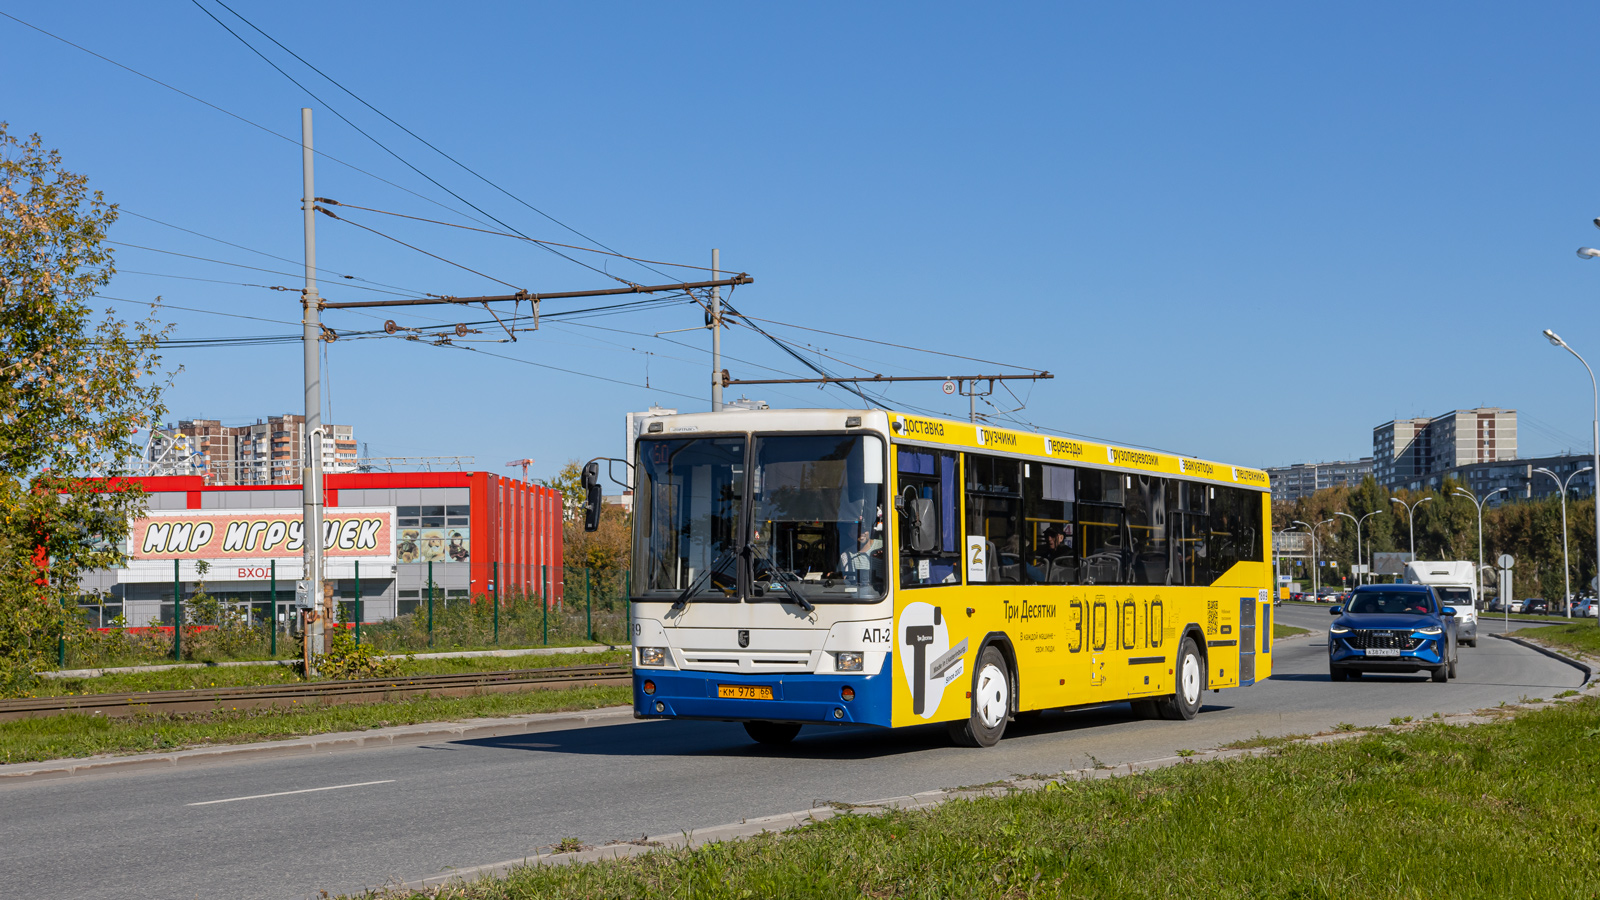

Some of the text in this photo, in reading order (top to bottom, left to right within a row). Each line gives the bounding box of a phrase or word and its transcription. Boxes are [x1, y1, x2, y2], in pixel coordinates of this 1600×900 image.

[143, 521, 213, 553] МИР
[238, 567, 272, 579] ВХОД
[1003, 600, 1056, 623] Три Десятки
[862, 628, 890, 643] АП-2
[723, 686, 770, 698] КМ 978 66
